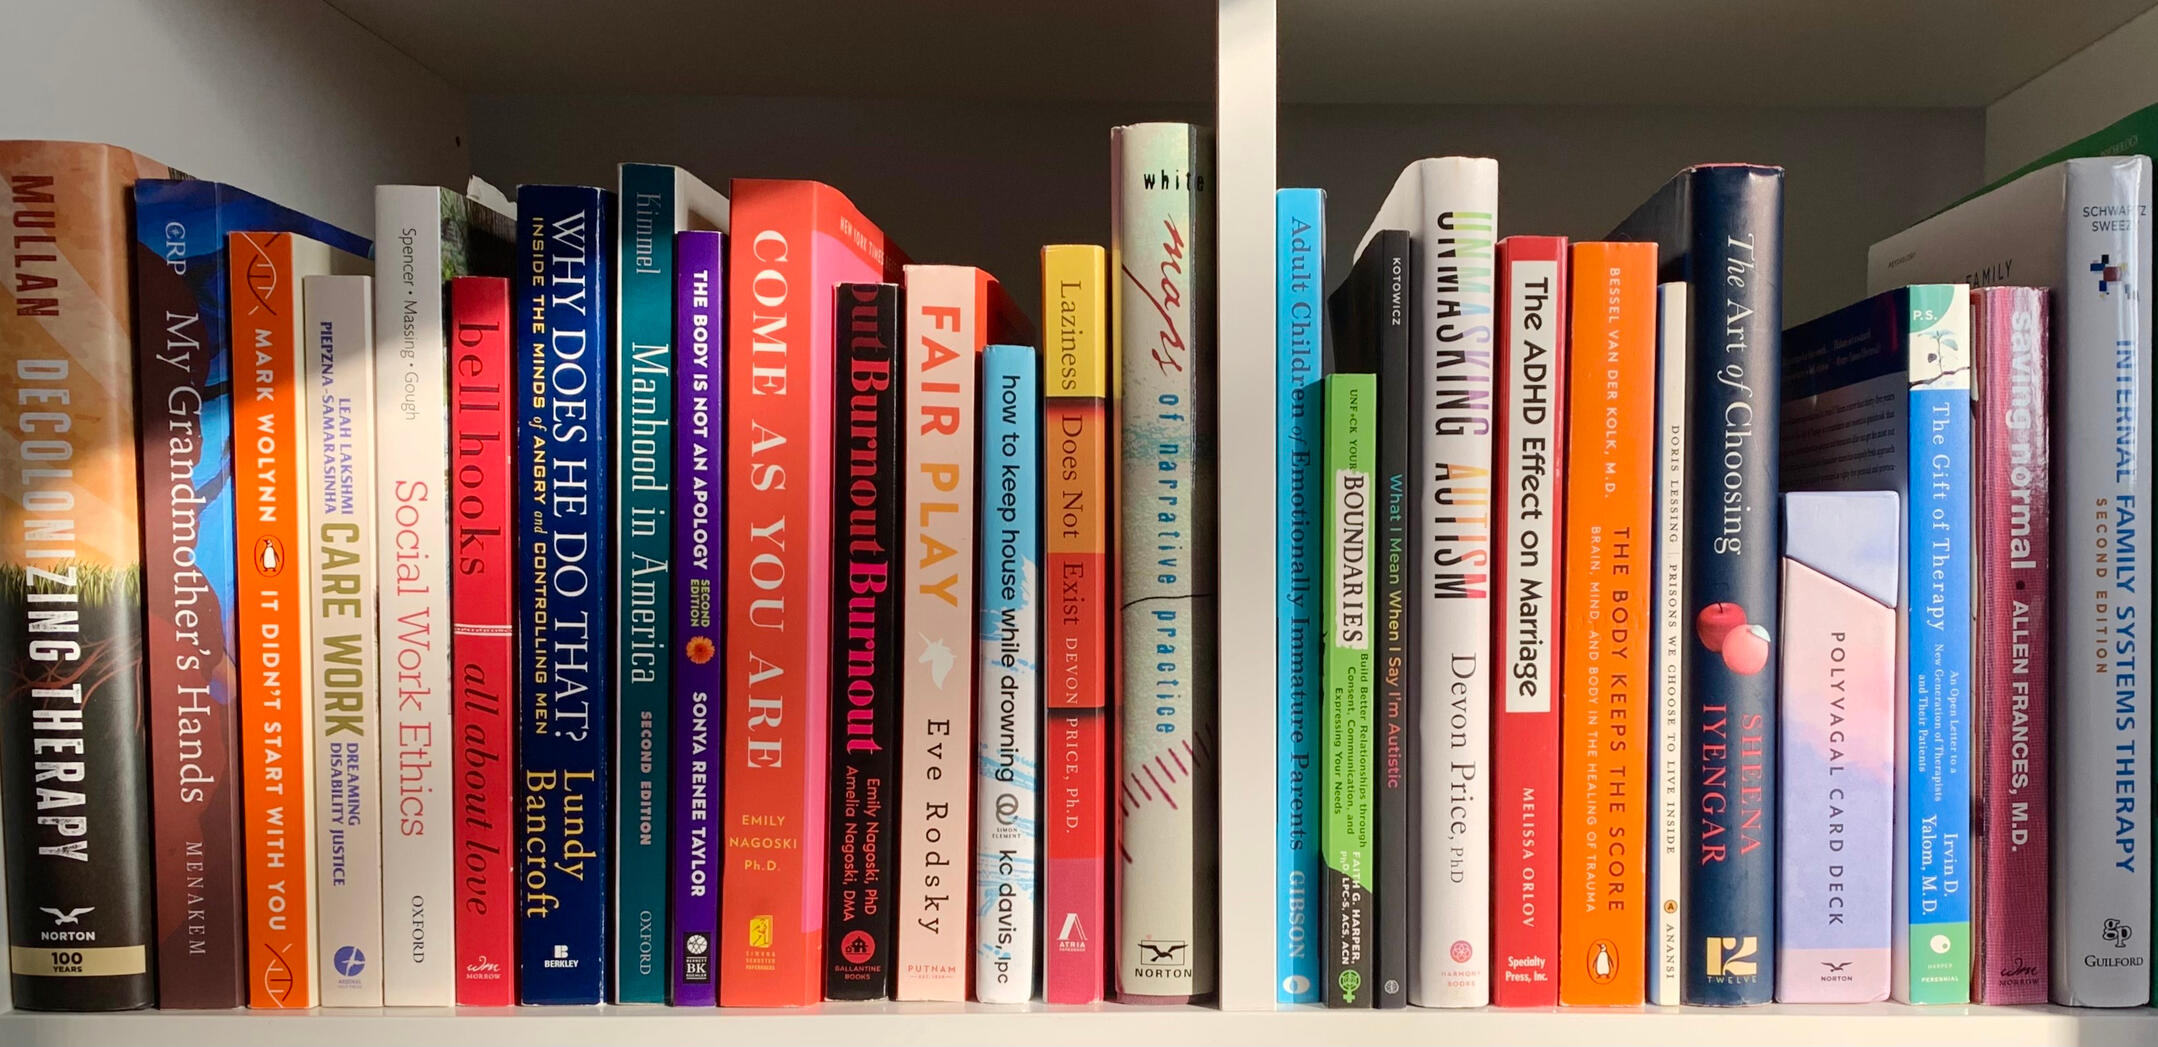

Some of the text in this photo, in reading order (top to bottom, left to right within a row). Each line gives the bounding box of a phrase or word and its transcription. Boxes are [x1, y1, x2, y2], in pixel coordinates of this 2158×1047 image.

[11, 175, 59, 316] MULLAN
[636, 192, 661, 274] Kimmel
[1392, 257, 1401, 325] KOTOWICZ
[399, 228, 418, 420] Spencer Massing Gough
[752, 230, 788, 396] COME
[920, 305, 961, 437] FAIR
[1604, 267, 1621, 498] BESSEL VAN DER KOLK, M.D.
[1913, 310, 1937, 321] P.S.
[254, 328, 277, 522] MARK WOLYNN
[458, 321, 501, 575] bell hooks
[552, 327, 587, 443] DOES
[693, 270, 708, 570] THE BODY IS NOT AN APOLOGY
[1060, 280, 1084, 625] Laziness Exist
[1434, 211, 1492, 598] UNMASKING AUTISM
[339, 398, 355, 515] LEAH LAKSHMI
[532, 217, 548, 735] INSIDE THE MINDS ANGRY and CONTROLLING MEN
[632, 342, 669, 684] Manhood America
[1669, 426, 1680, 543] DORIS LESSING
[1714, 401, 1753, 555] Choosing
[2010, 443, 2036, 569] normal
[1151, 443, 1184, 734] narrative practice
[1287, 216, 1312, 850] Adult Children Emotionally Immature Parents
[1343, 475, 1364, 643] BOUNDARIES
[1514, 438, 1546, 697] Effect Marriage
[1926, 537, 1950, 632] Therapy
[2096, 498, 2107, 673] SECOND EDITION
[17, 359, 88, 862] DECOLONIZING THERAPY
[320, 522, 364, 737] CARE WORK
[395, 481, 432, 836] Social Work Ethics
[690, 579, 700, 627] EDITION
[700, 579, 710, 628] SECOND
[995, 530, 1020, 782] house while drowning
[1387, 474, 1403, 789] What Mean When Autistic
[2012, 601, 2029, 674] ALLEN
[177, 684, 215, 804] Hands
[1064, 638, 1079, 833] DEVON PRICE, Ph.D.
[1334, 688, 1343, 747] Expressing
[1586, 527, 1601, 912] BRAIN, AND BODY IN THE HEALING OF TRAUMA
[1666, 564, 1677, 854] PRISONS WE CHOOSE TO LIVE INSIDE
[2115, 495, 2135, 873] FAMILY SYSTEMS THERAPY
[264, 722, 284, 868] START WITH
[330, 743, 346, 886] DISABILITY JUSTICE
[346, 743, 360, 826] DREAMING
[464, 723, 500, 915] about love
[554, 769, 597, 881] Lundy
[640, 711, 653, 846] SECOND EDITION
[691, 692, 707, 896] SONYA RENEE TAYLOR
[742, 815, 785, 826] EMILY
[1358, 725, 1368, 848] Relationships through
[1450, 652, 1476, 884] Devon PhD
[1608, 674, 1628, 912] KEEPS SCORE
[1702, 704, 1727, 866] IYENGAR
[1740, 713, 1763, 855] SHEENA
[1829, 632, 1846, 926] POLYVAGAL CARD DECK
[186, 841, 206, 955] MENAKEM
[526, 769, 560, 919] Bancroft
[729, 837, 797, 849] NAGOSKI
[843, 766, 860, 922] Amelia DMA
[864, 778, 880, 915] Emily PhD
[918, 801, 949, 934] Rodsky
[1522, 787, 1535, 928] MELISSA ORLOV
[1921, 814, 1937, 916] Yalom, M.D.
[1944, 833, 1959, 877] Irvin
[41, 931, 96, 941] NORTON
[51, 952, 83, 965] 100
[411, 895, 424, 963] OXFORD
[544, 959, 579, 968] BERKLEY
[640, 910, 652, 975] OXFORD
[687, 962, 707, 973] BK
[907, 965, 956, 973] PUTNAM
[1135, 968, 1192, 978] NORTON
[1289, 871, 1305, 958] GIBSON
[1505, 971, 1548, 983] Press, Inc.
[1508, 956, 1546, 969] Specialty
[1666, 924, 1674, 978] ANANSI
[1707, 976, 1757, 984] TWELVE
